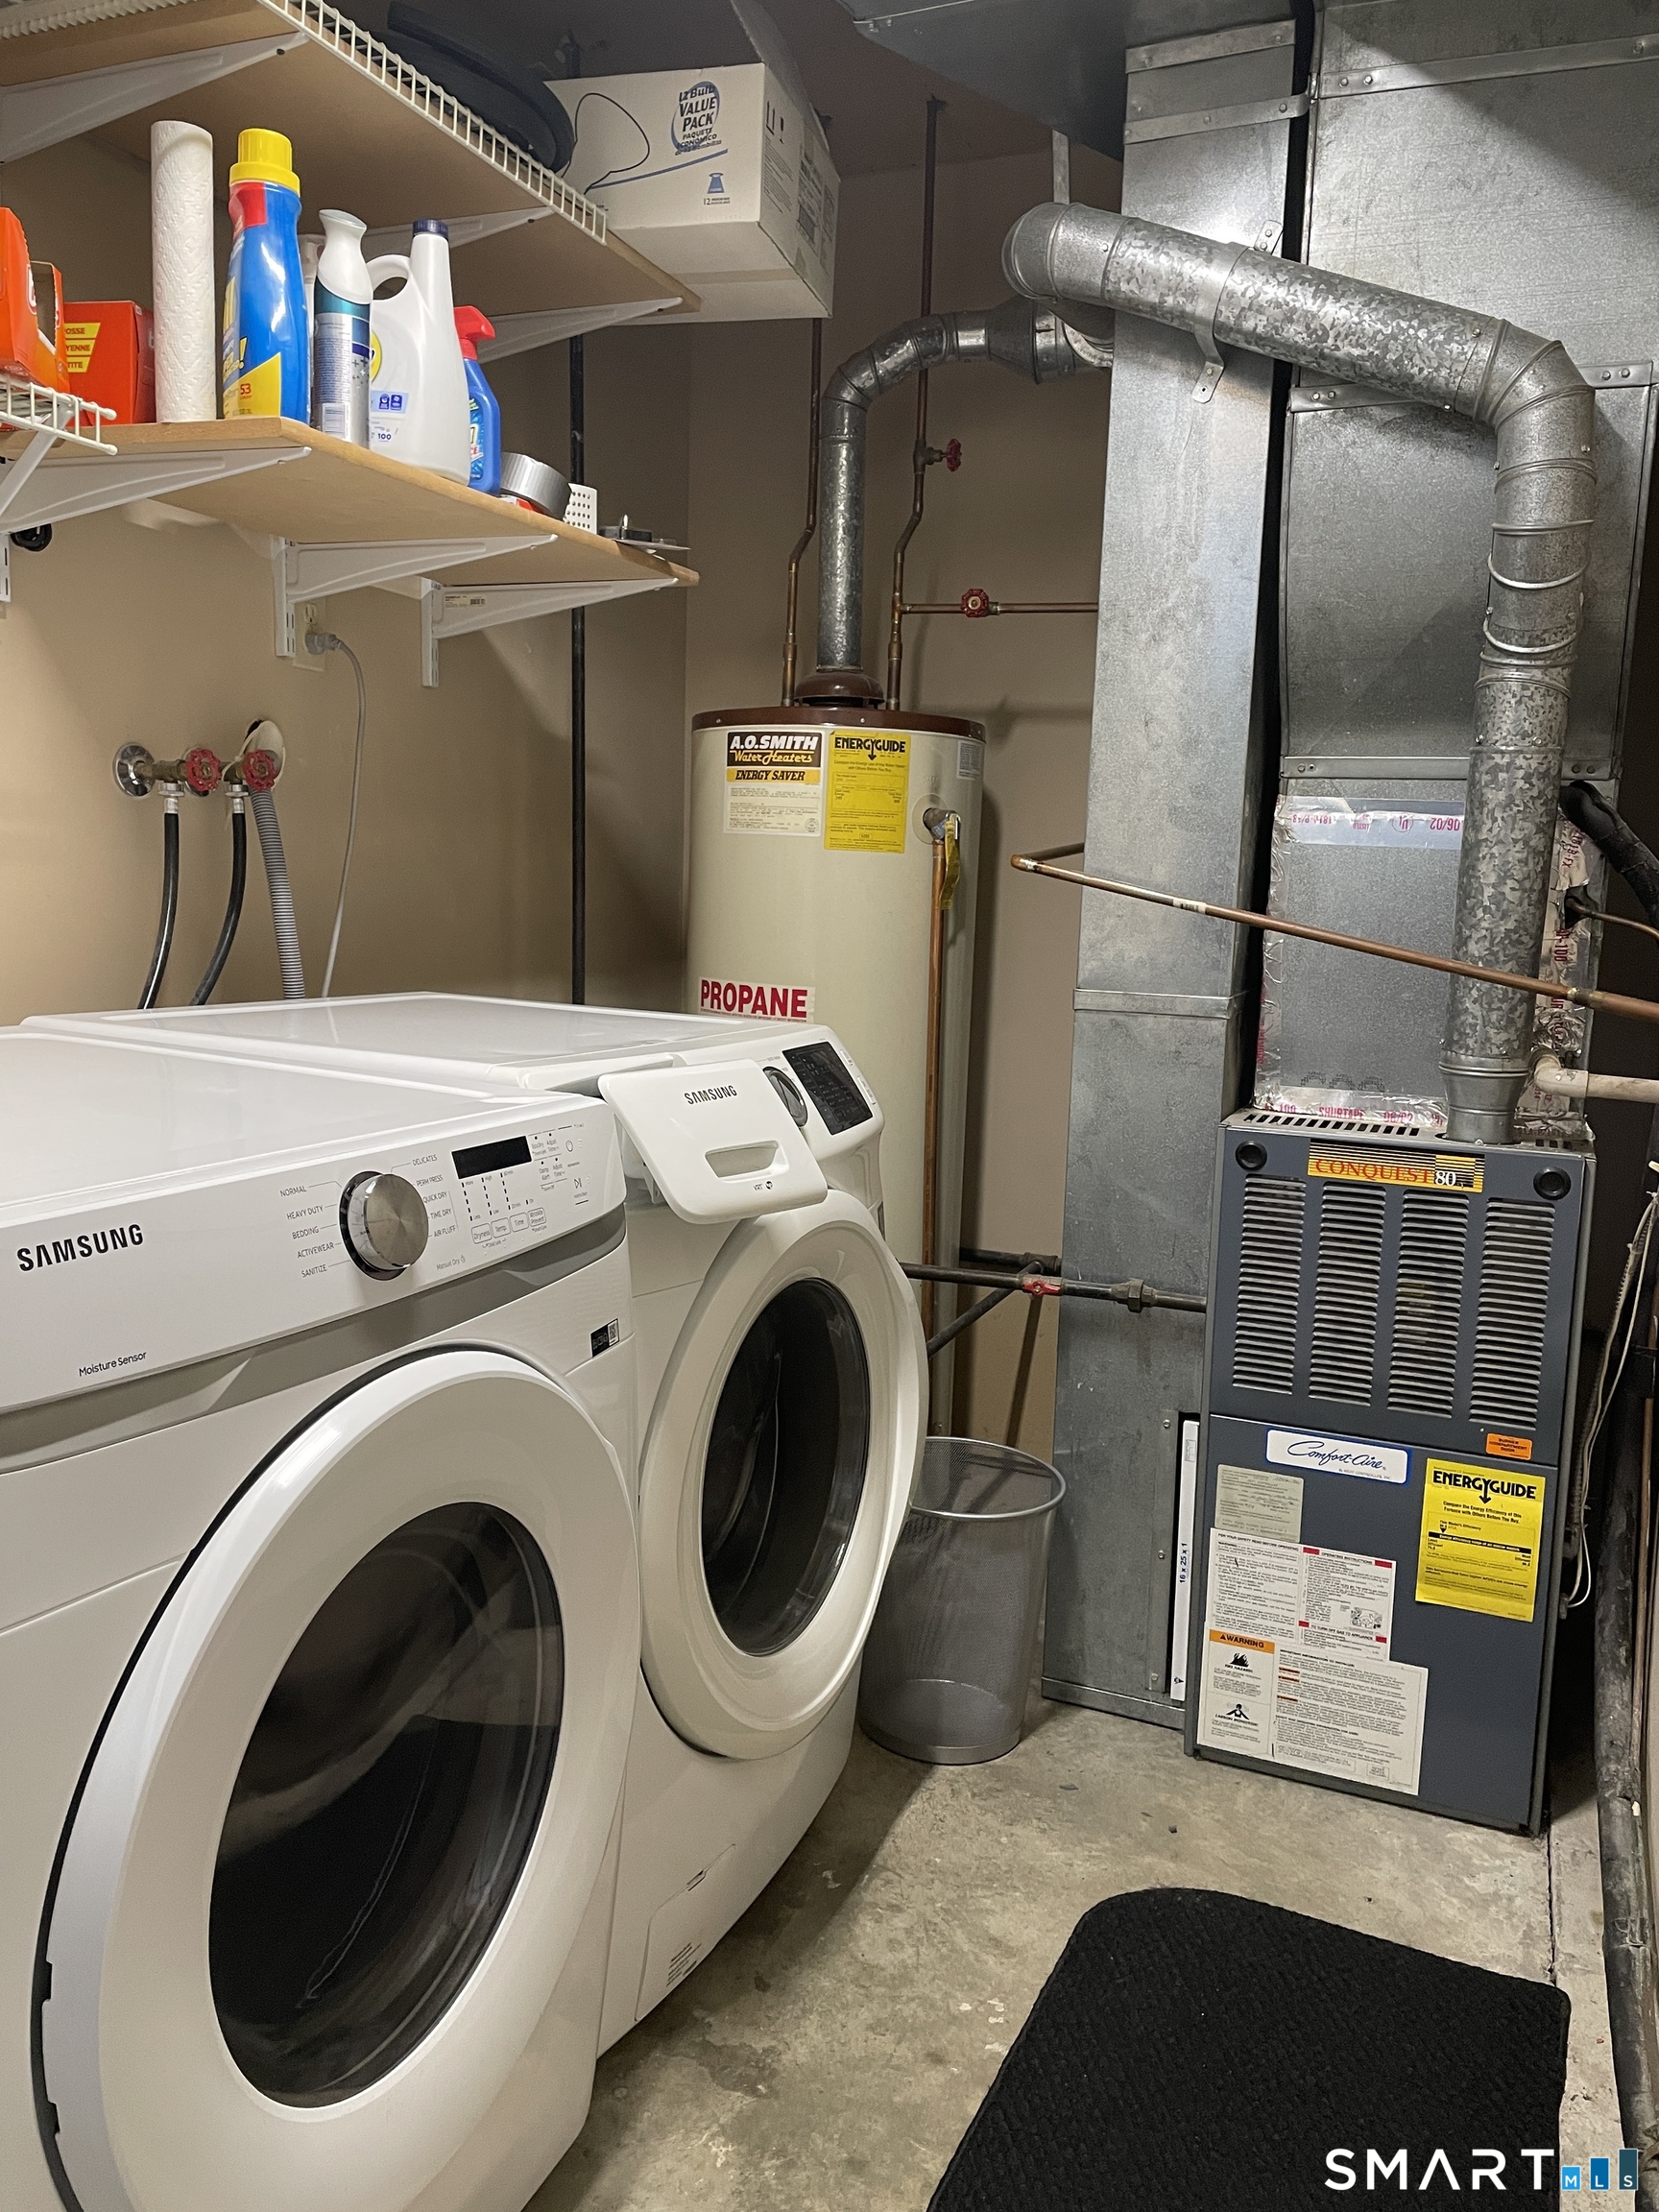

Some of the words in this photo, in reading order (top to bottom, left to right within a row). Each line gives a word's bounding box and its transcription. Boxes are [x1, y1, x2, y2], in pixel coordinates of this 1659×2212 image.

[679, 96, 716, 117] VALUE
[682, 111, 714, 132] PACK
[65, 344, 90, 352] YENNE
[240, 383, 252, 396] 53
[834, 736, 906, 754] ENERGYGUIDE
[733, 751, 762, 762] Water
[762, 751, 812, 765] Heaters
[735, 770, 772, 781] ENERGY
[771, 770, 805, 781] SAVER
[1430, 816, 1459, 831] 06/02
[701, 979, 807, 1018] PROPANE
[685, 1085, 737, 1105] SAMSUNG
[413, 1154, 438, 1166] DELICATES
[429, 1174, 444, 1184] PRESS
[1315, 1159, 1434, 1184] CONQUEST
[1434, 1170, 1456, 1187] 80
[279, 1185, 307, 1197] NORMAL
[423, 1195, 438, 1204] QUICK
[438, 1190, 447, 1200] DRY
[286, 1209, 307, 1220] HEAVY
[307, 1205, 324, 1215] DUTY
[430, 1211, 442, 1220] TIME
[442, 1208, 452, 1216] DRY
[292, 1226, 320, 1239] BEDDING
[442, 1225, 456, 1235] FLUFF
[473, 1231, 491, 1240] Dryness
[16, 1224, 143, 1272] SAMSUNG
[297, 1242, 334, 1259] ACTIVEWEAR
[452, 1258, 461, 1267] Dry
[301, 1263, 327, 1278] SANITIZE
[79, 1358, 117, 1377] Moisture
[117, 1352, 147, 1367] Sensor
[1286, 1440, 1383, 1469] Comfort-Aire
[1433, 1470, 1536, 1499] ENERGYGUIDE
[1470, 1504, 1484, 1513] Energy
[1485, 1507, 1507, 1517] Efficiency
[1180, 1555, 1187, 1566] 25
[1321, 1551, 1344, 1560] OPERATING
[1344, 1555, 1373, 1565] INSTRUCTIONS
[1179, 1575, 1187, 1583] 16
[1226, 1634, 1264, 1648] WARNING
